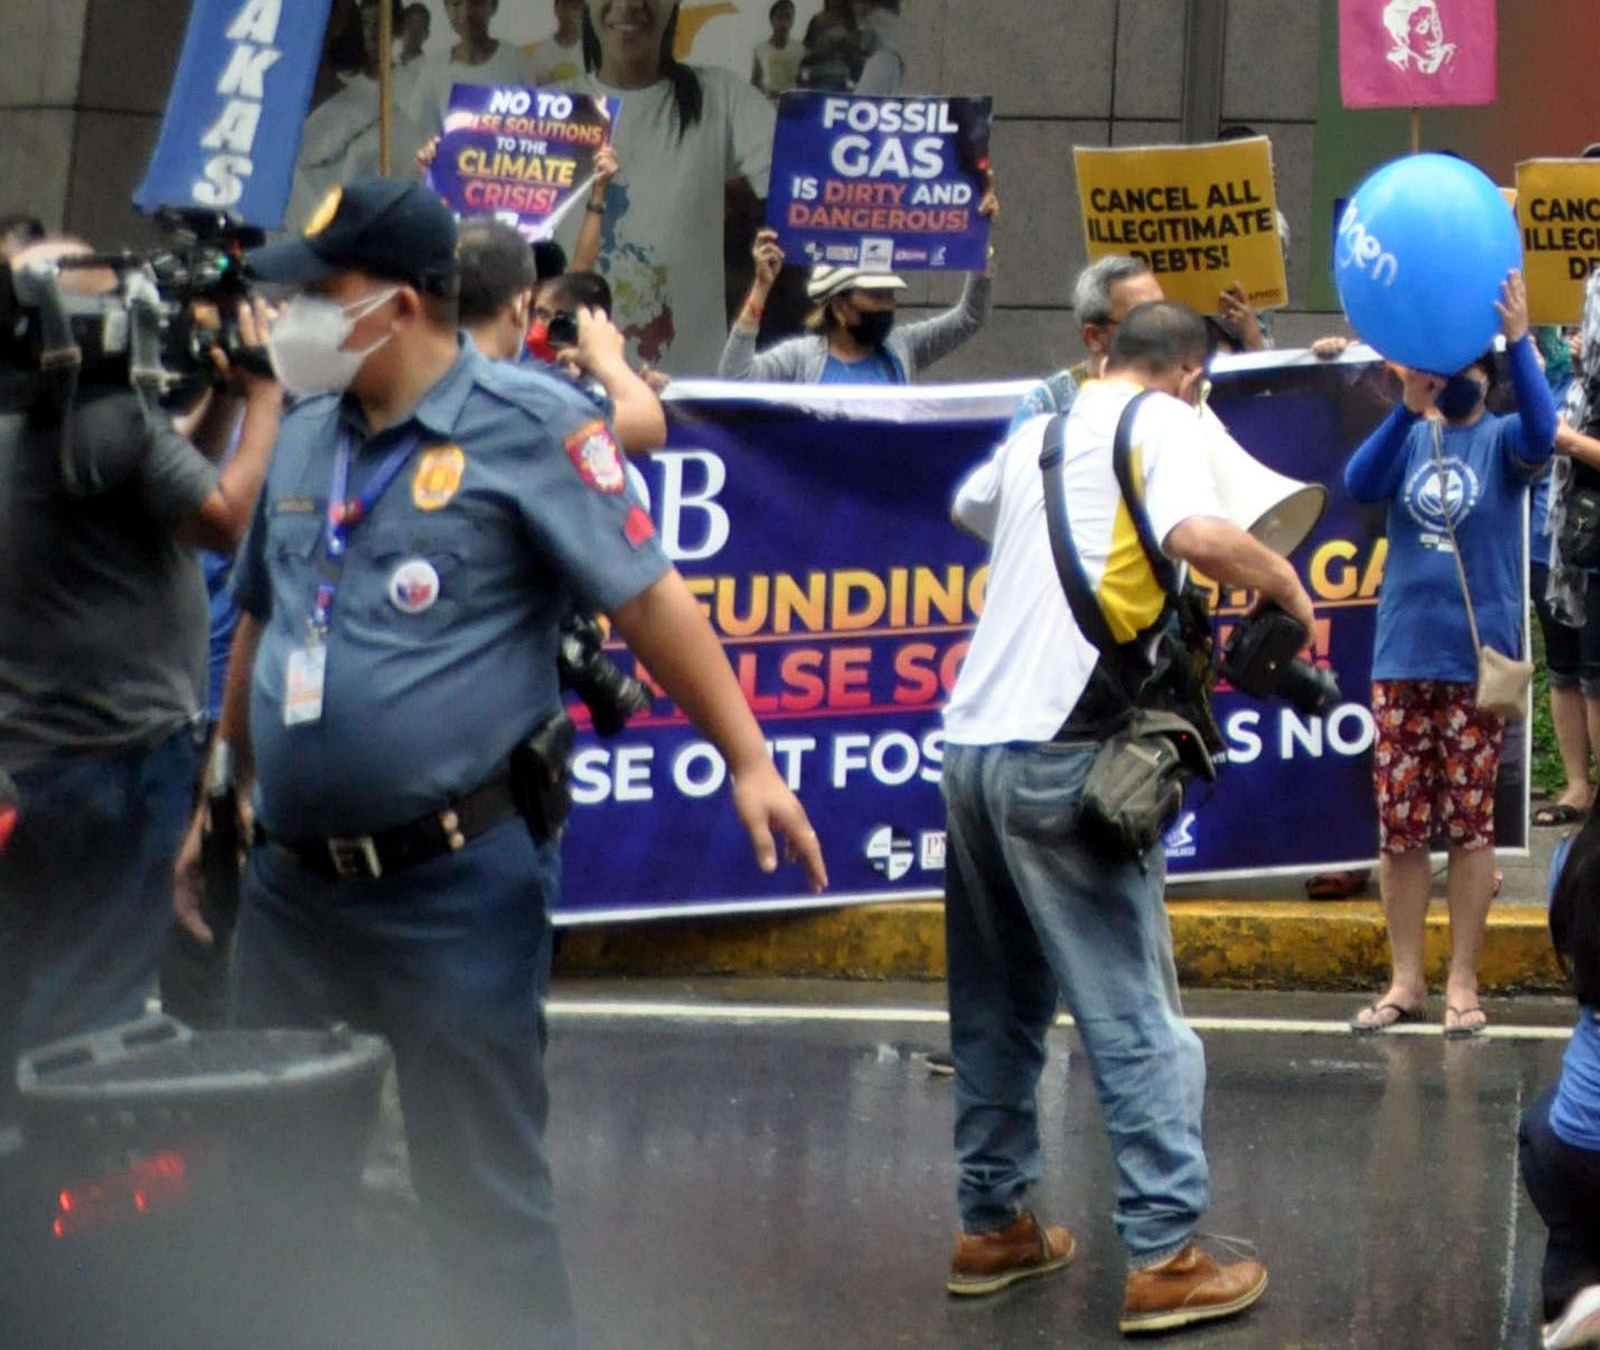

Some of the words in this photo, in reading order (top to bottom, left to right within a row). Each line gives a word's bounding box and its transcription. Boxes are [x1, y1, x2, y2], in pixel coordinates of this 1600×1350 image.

[489, 90, 531, 116] NO
[536, 93, 573, 120] TO
[822, 99, 960, 134] FOSSIL
[496, 136, 516, 151] TO
[519, 139, 548, 156] THE
[505, 117, 604, 144] SOLUTIONS
[457, 149, 577, 185] CLIMATE
[830, 134, 945, 179] GAS
[464, 180, 558, 214] CRISIS!
[791, 176, 818, 200] IS
[824, 180, 909, 205] DIRTY
[911, 183, 973, 205] AND
[1090, 186, 1199, 213] CANCEL
[1206, 179, 1262, 209] ALL
[788, 204, 970, 233] DANGEROUS!
[1087, 207, 1274, 244] ILLEGITIMATE
[673, 736, 817, 799] OT
